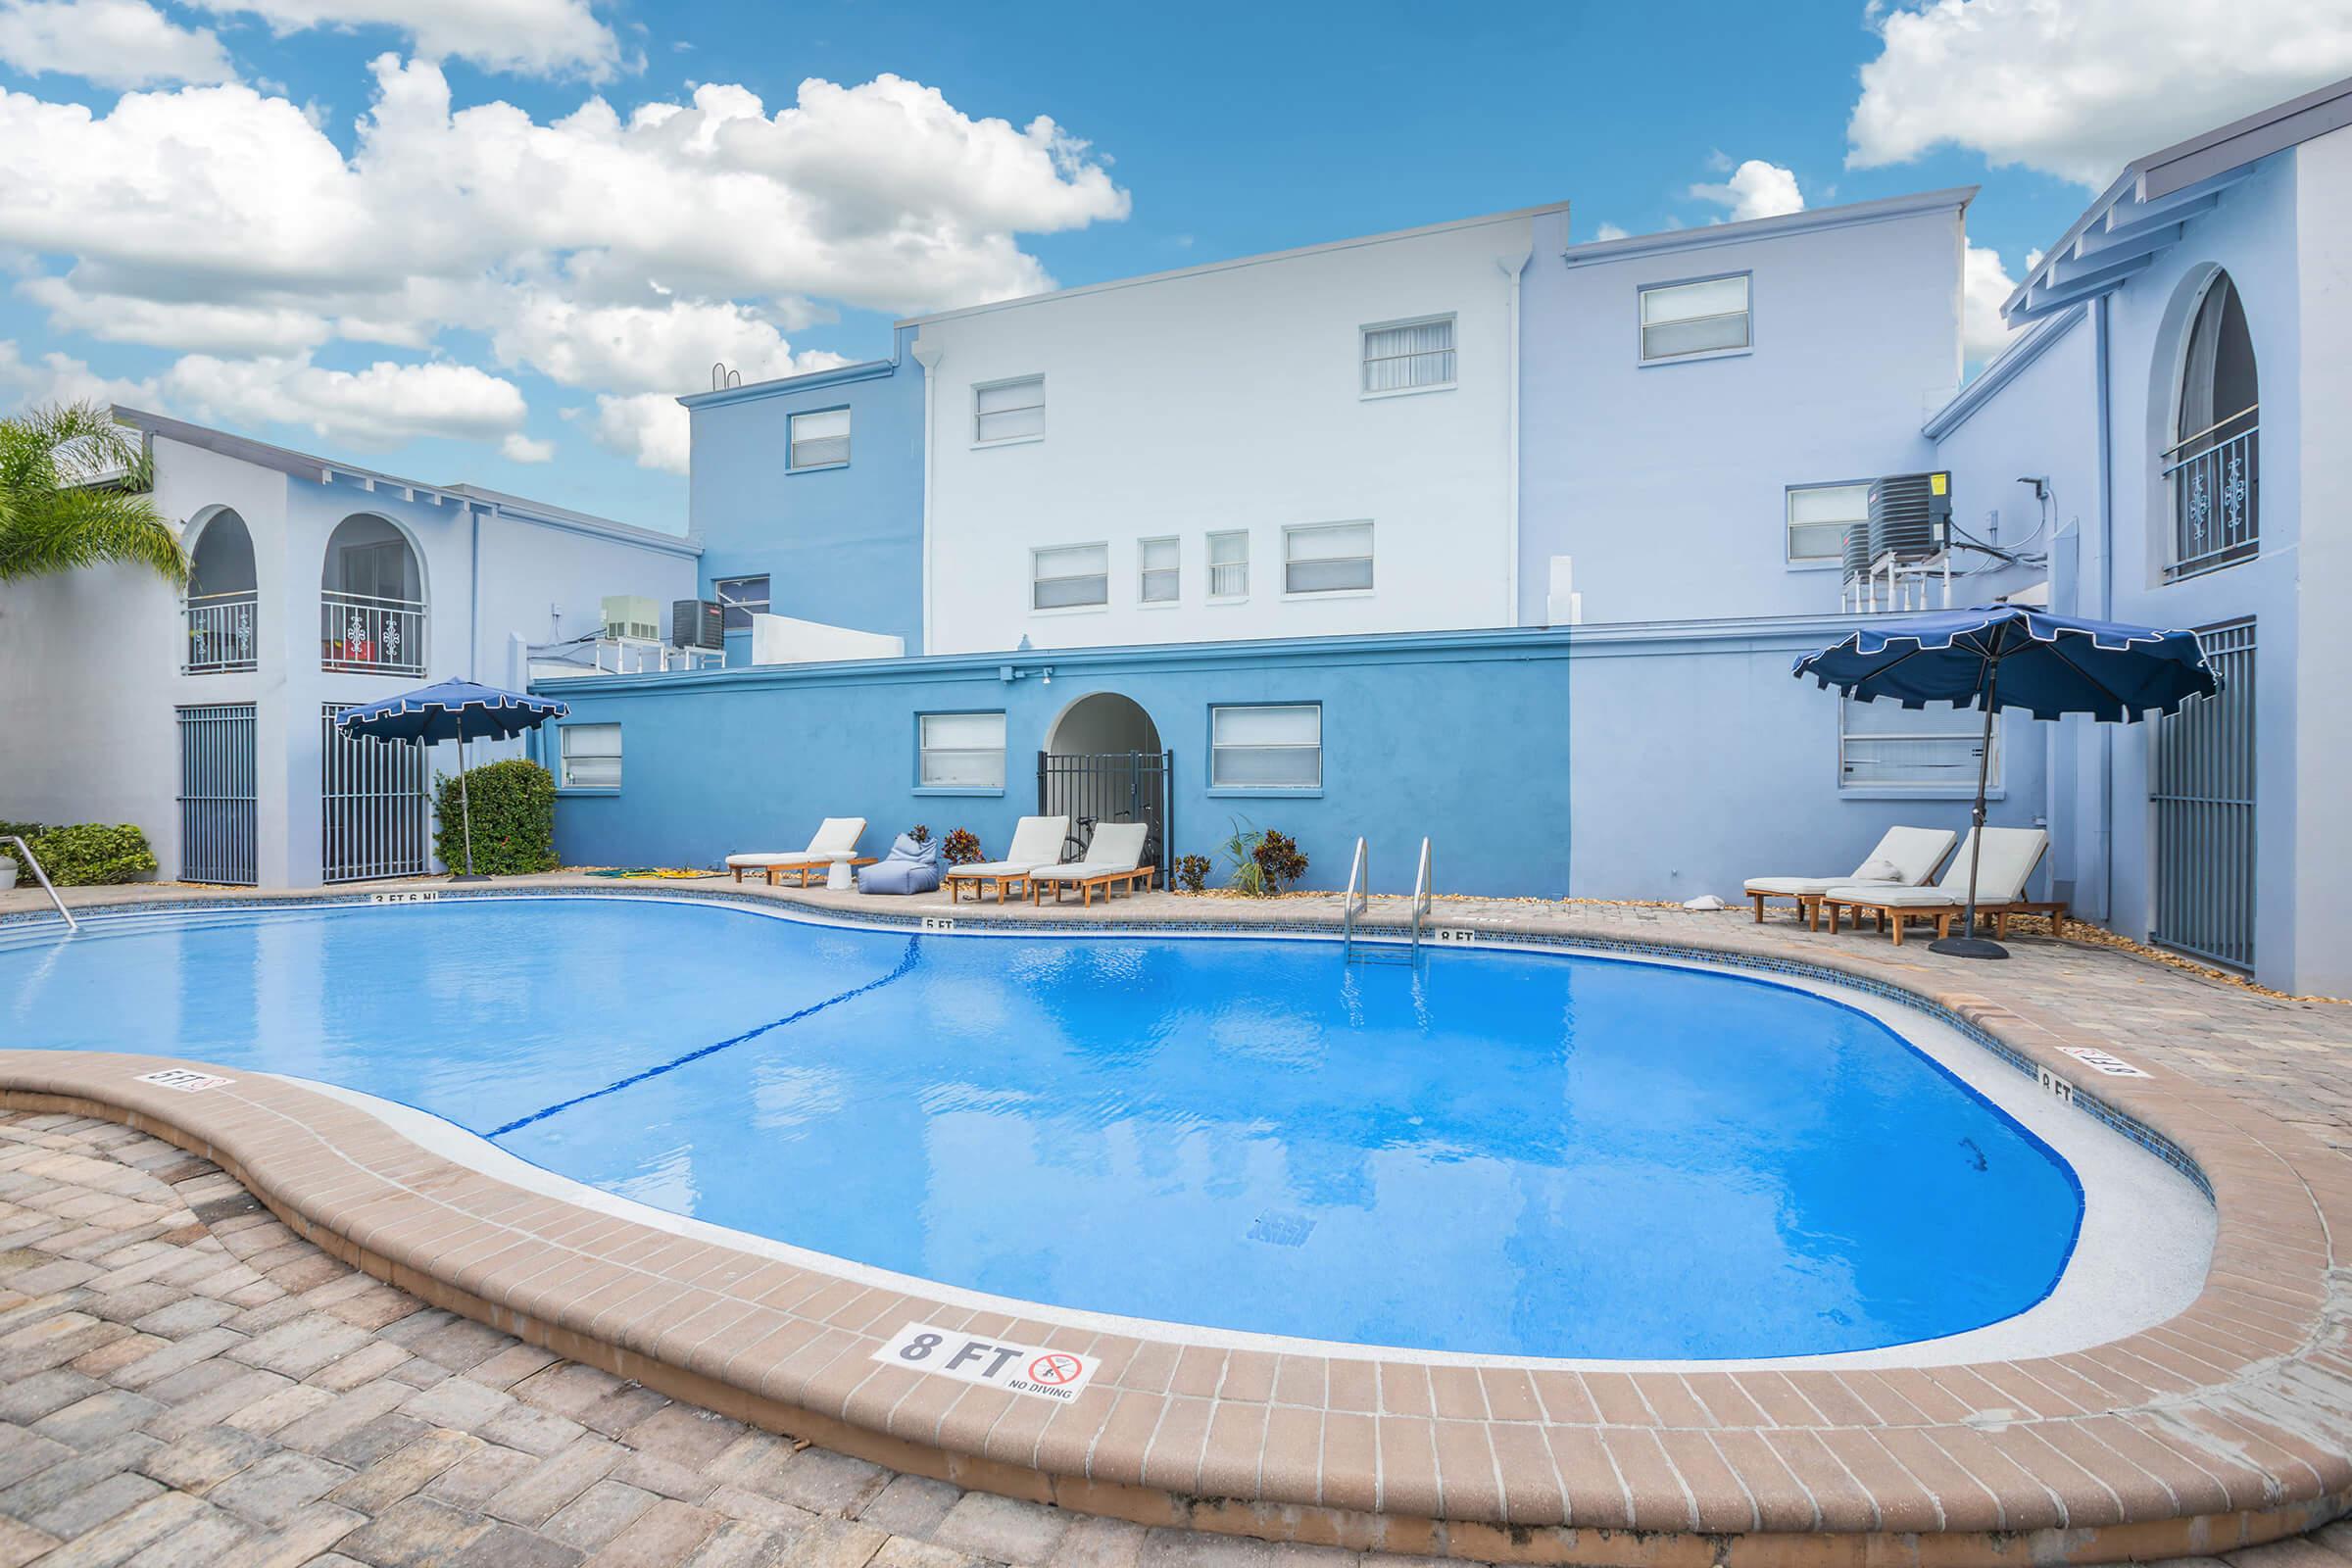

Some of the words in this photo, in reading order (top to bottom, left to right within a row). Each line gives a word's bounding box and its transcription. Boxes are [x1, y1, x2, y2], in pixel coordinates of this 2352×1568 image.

[938, 920, 953, 929] FT
[1456, 931, 1473, 941] FT
[148, 1070, 184, 1079] 5
[161, 1074, 207, 1085] FT
[900, 1333, 943, 1361] 8
[945, 1341, 1024, 1379] FT
[1007, 1379, 1028, 1390] NO
[1029, 1383, 1073, 1399] DIVING
